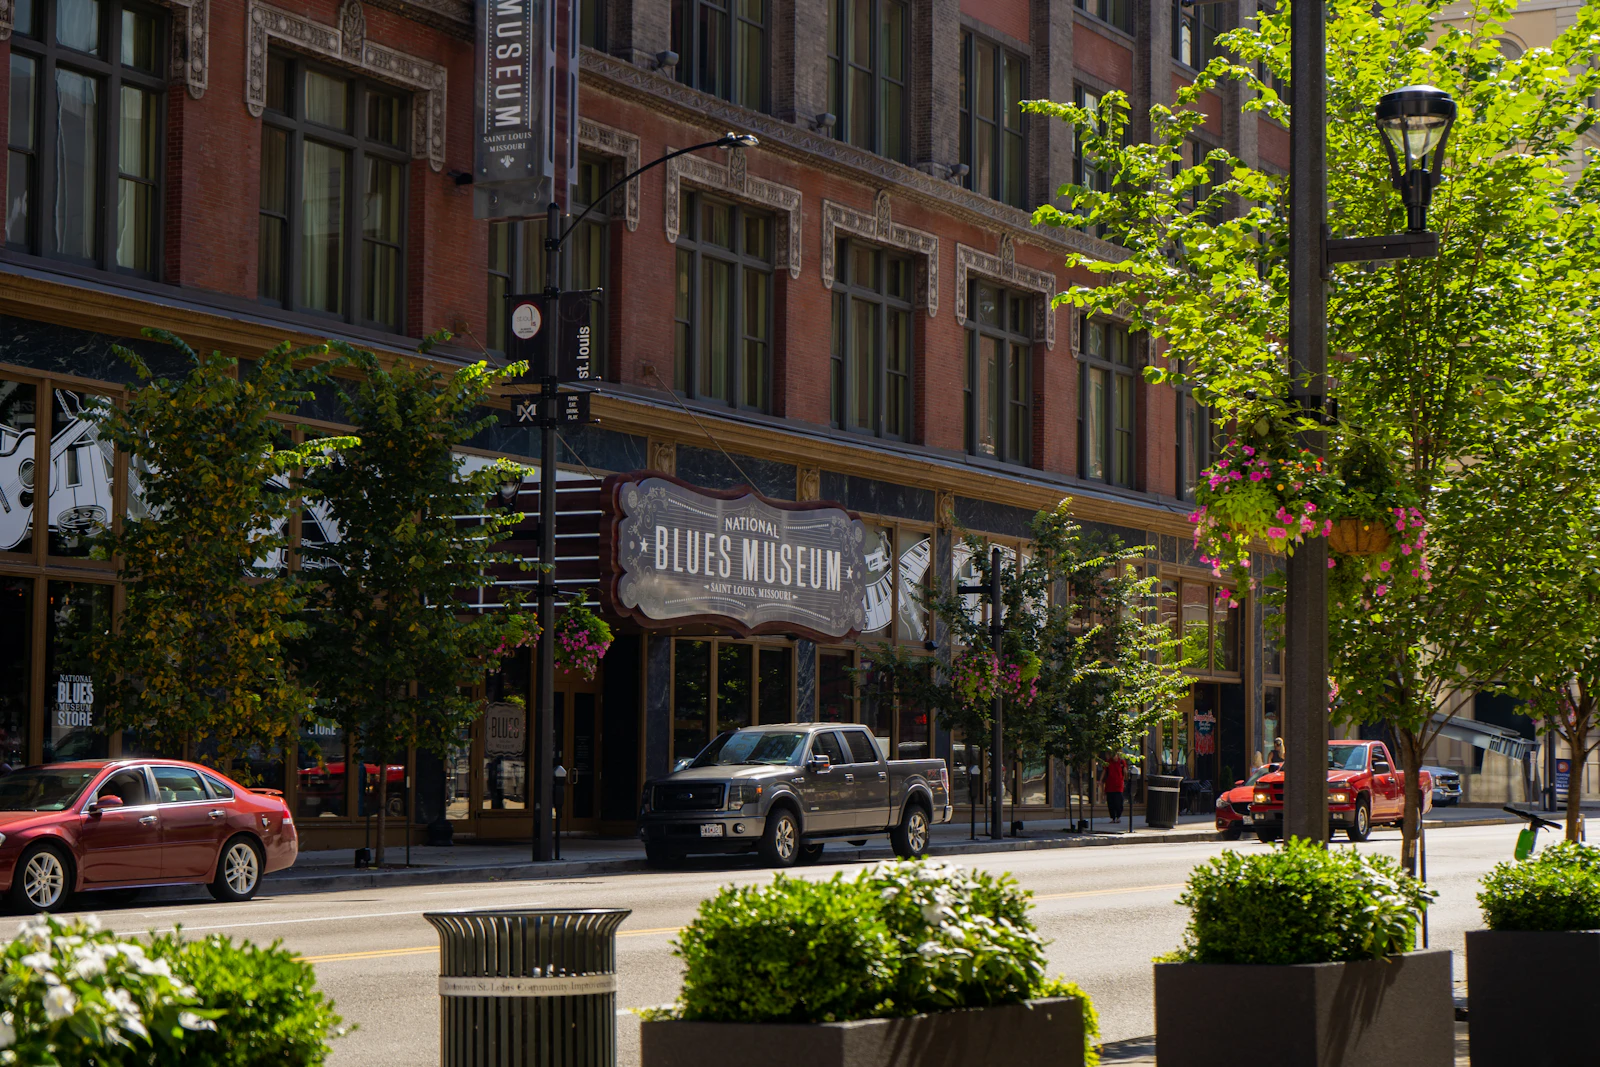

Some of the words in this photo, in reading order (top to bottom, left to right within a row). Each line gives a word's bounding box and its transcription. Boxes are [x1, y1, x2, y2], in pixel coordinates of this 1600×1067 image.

[495, 0, 522, 127] MUSEUM
[484, 134, 506, 143] SAINT
[508, 132, 532, 141] LOUIS
[490, 142, 526, 152] MISSOURI
[576, 326, 590, 360] louis
[576, 361, 590, 379] st.
[725, 517, 780, 539] NATIONAL
[655, 525, 732, 579] BLUES
[742, 538, 841, 592] MUSEUM
[710, 582, 732, 594] SAINT
[733, 585, 757, 598] LOUIS,
[758, 588, 791, 600] MISSOURI
[60, 674, 93, 682] NATIONAL
[57, 681, 94, 705] BLUES
[58, 703, 92, 711] MUSEUM
[57, 711, 93, 727] STORE
[491, 716, 520, 739] BLUES
[517, 982, 568, 994] Community
